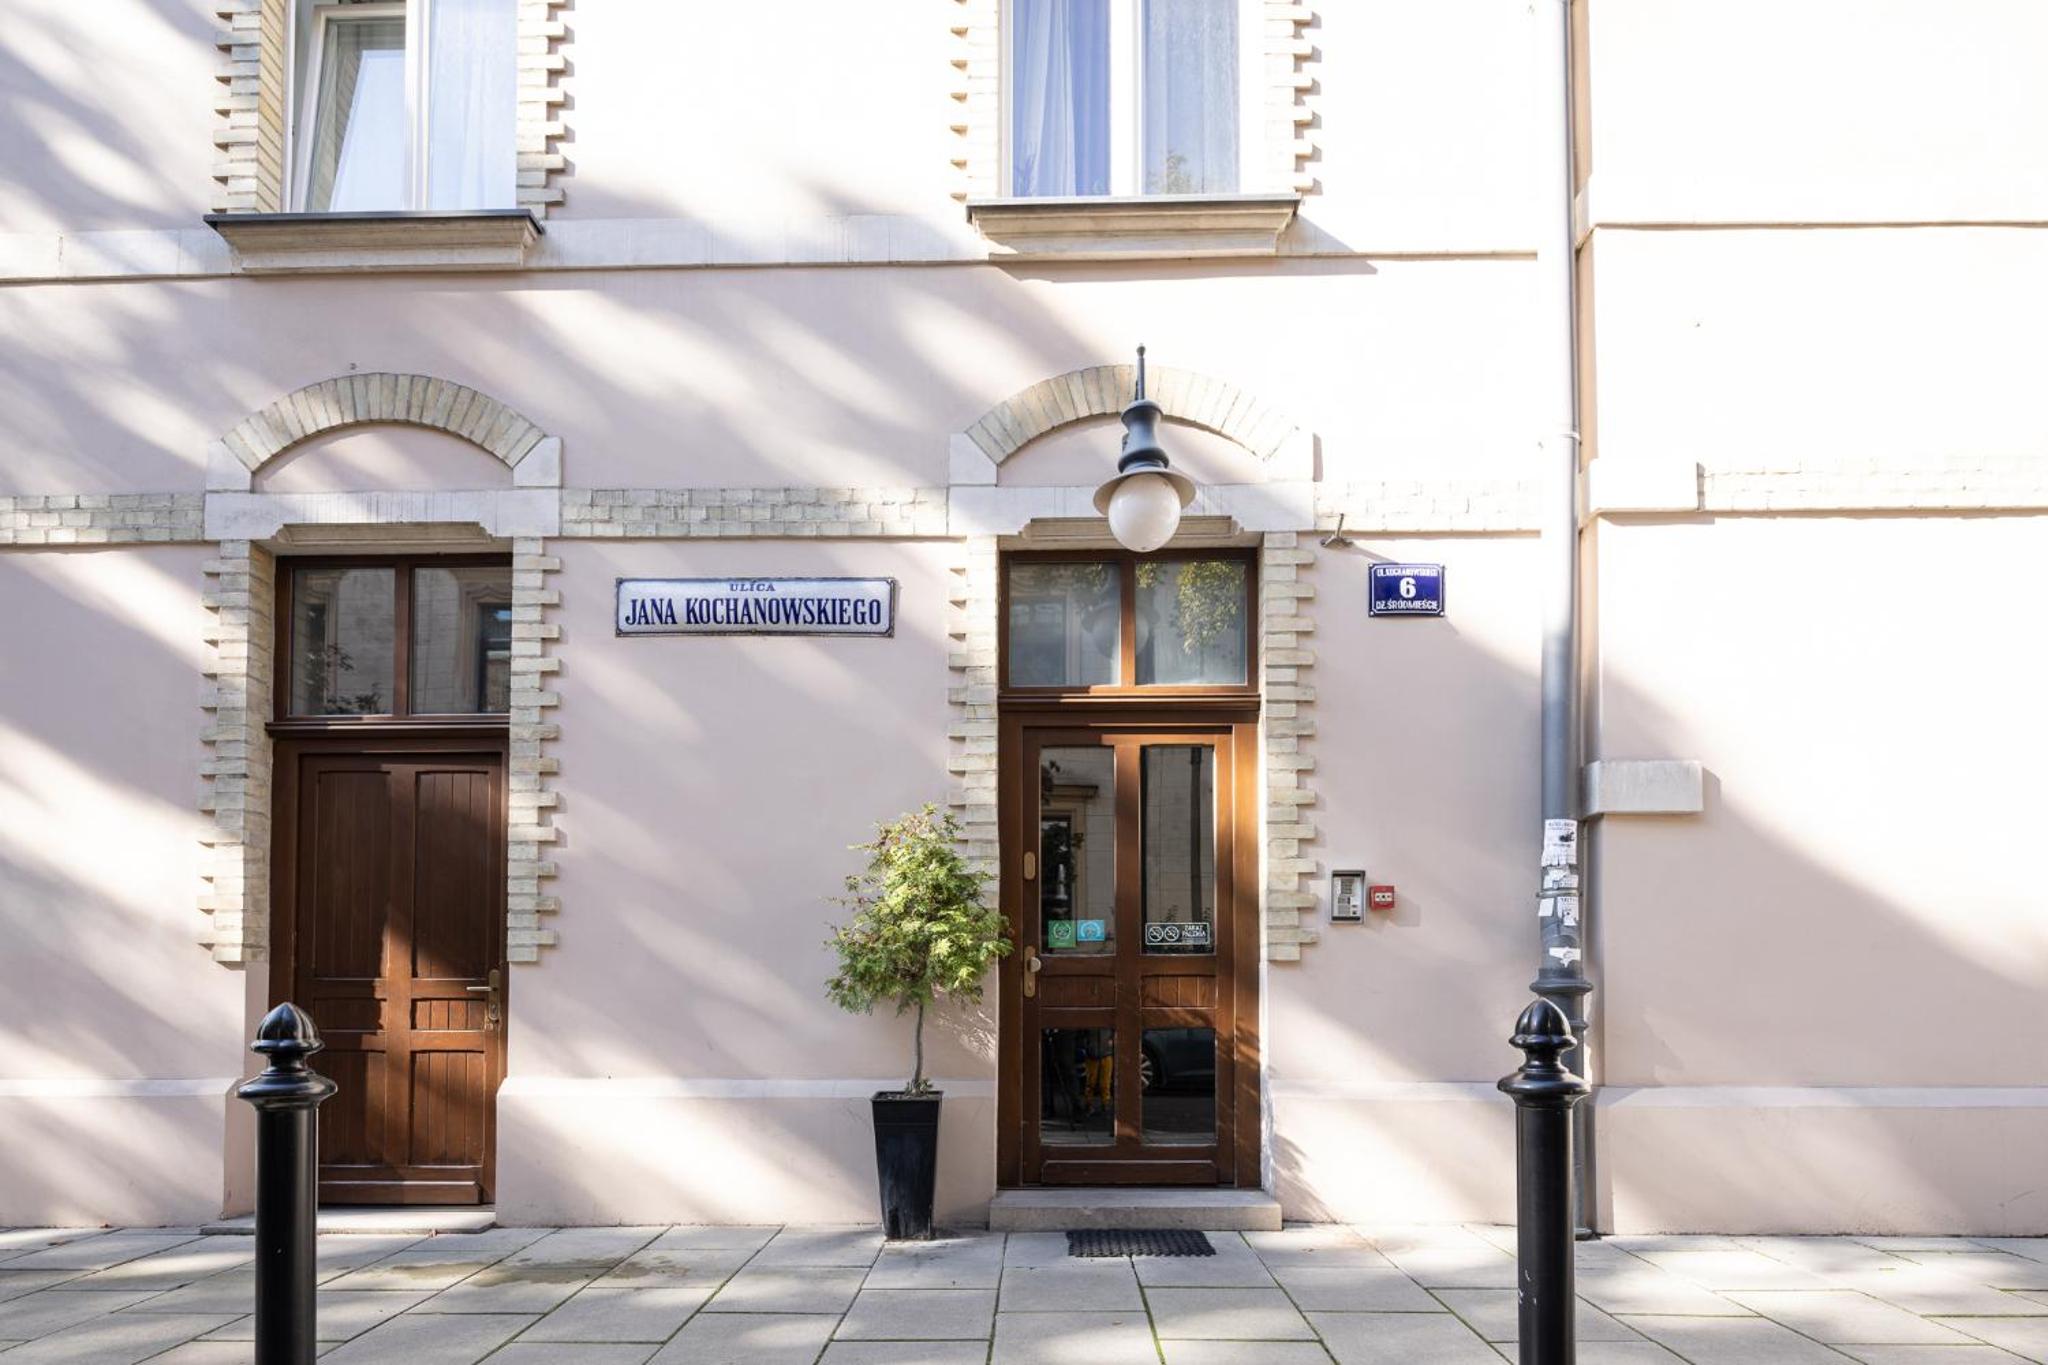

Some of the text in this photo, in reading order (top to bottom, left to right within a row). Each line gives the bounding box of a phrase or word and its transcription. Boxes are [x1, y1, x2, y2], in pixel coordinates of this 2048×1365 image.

[729, 583, 776, 592] ULICA
[1400, 577, 1417, 598] 6
[625, 597, 882, 626] JANA KOCHANOWSKIEGO
